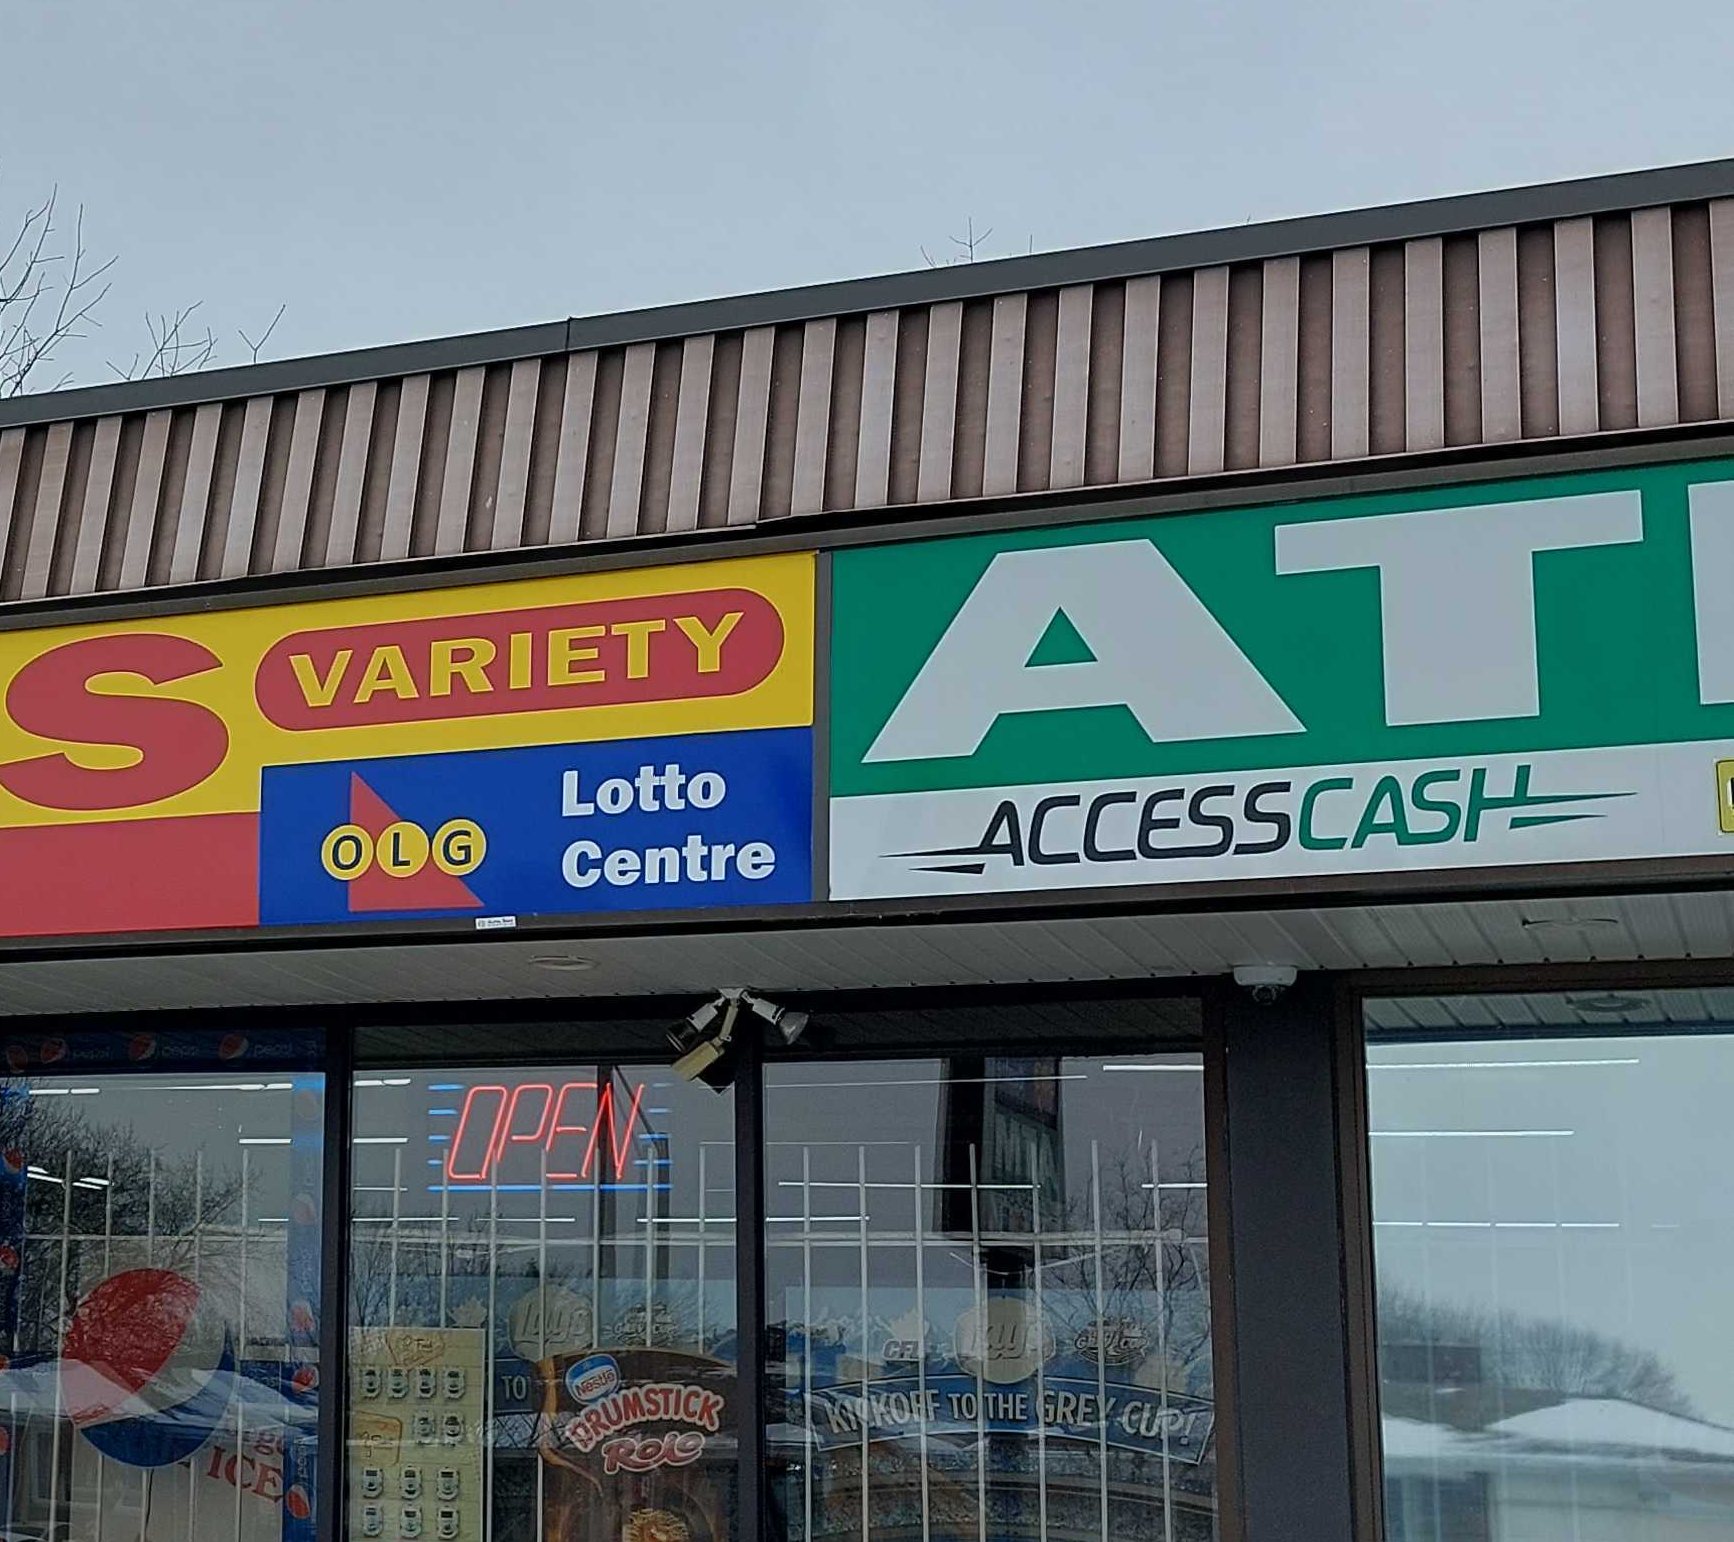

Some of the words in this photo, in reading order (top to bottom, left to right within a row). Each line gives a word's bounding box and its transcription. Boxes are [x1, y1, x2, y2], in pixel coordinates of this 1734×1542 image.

[861, 482, 1734, 763] AT
[289, 611, 745, 708] VARIETY
[562, 763, 726, 817] Lotto
[327, 825, 477, 872] OLG
[562, 834, 776, 888] Centre
[448, 1083, 644, 1179] OPEN
[568, 1385, 723, 1451] DRUMSTICK
[823, 1389, 941, 1435] KICKOFF
[948, 1393, 977, 1419] TO
[983, 1392, 1029, 1422] THE
[1038, 1390, 1116, 1427] GREY
[1121, 1400, 1196, 1446] CUP!
